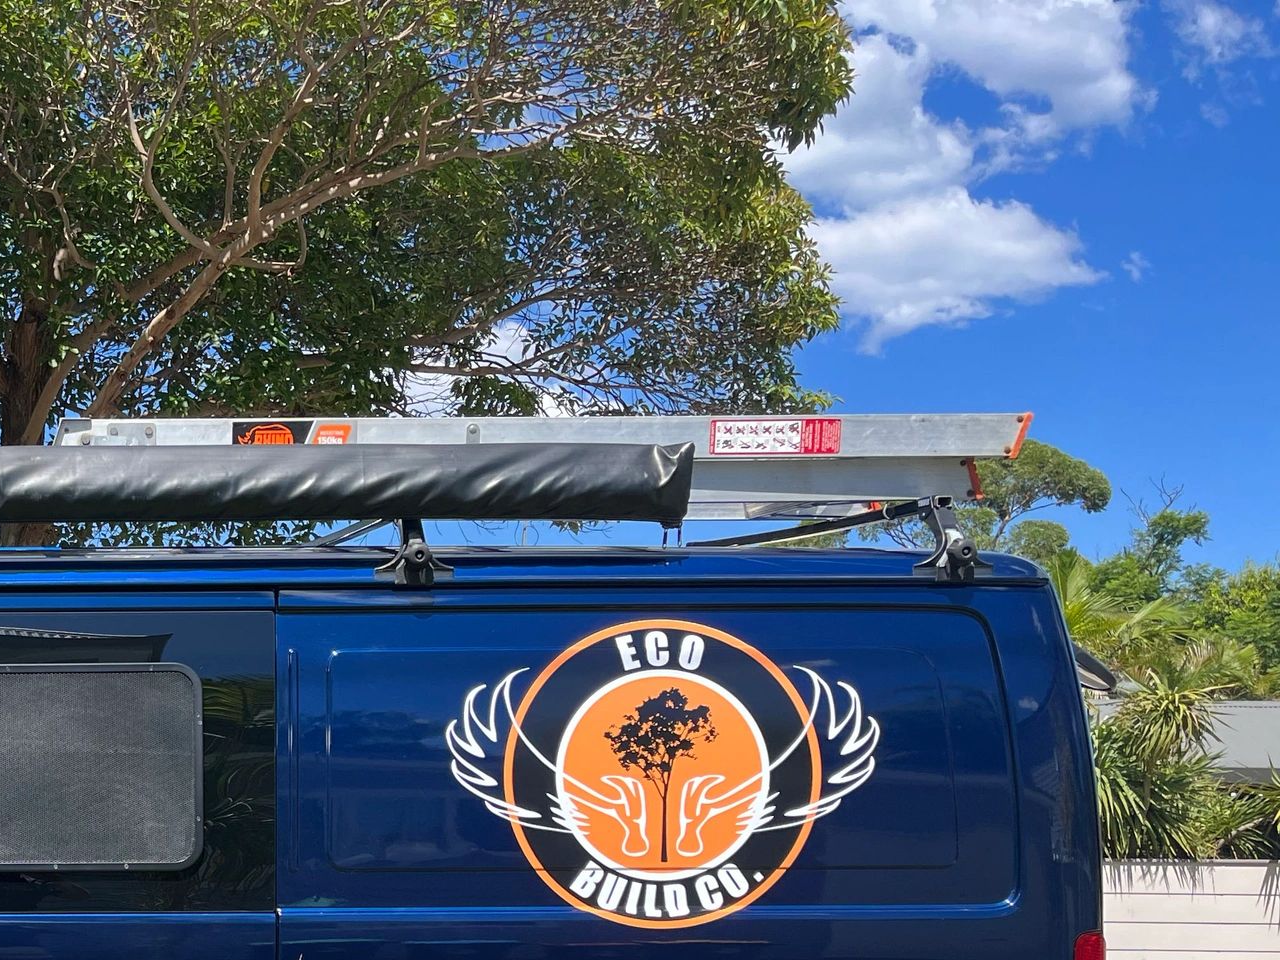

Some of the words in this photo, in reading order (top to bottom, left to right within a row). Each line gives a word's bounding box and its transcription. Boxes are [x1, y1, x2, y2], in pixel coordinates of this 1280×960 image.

[614, 630, 705, 672] ECO
[569, 860, 691, 918] BUILD
[696, 862, 765, 912] CO.
